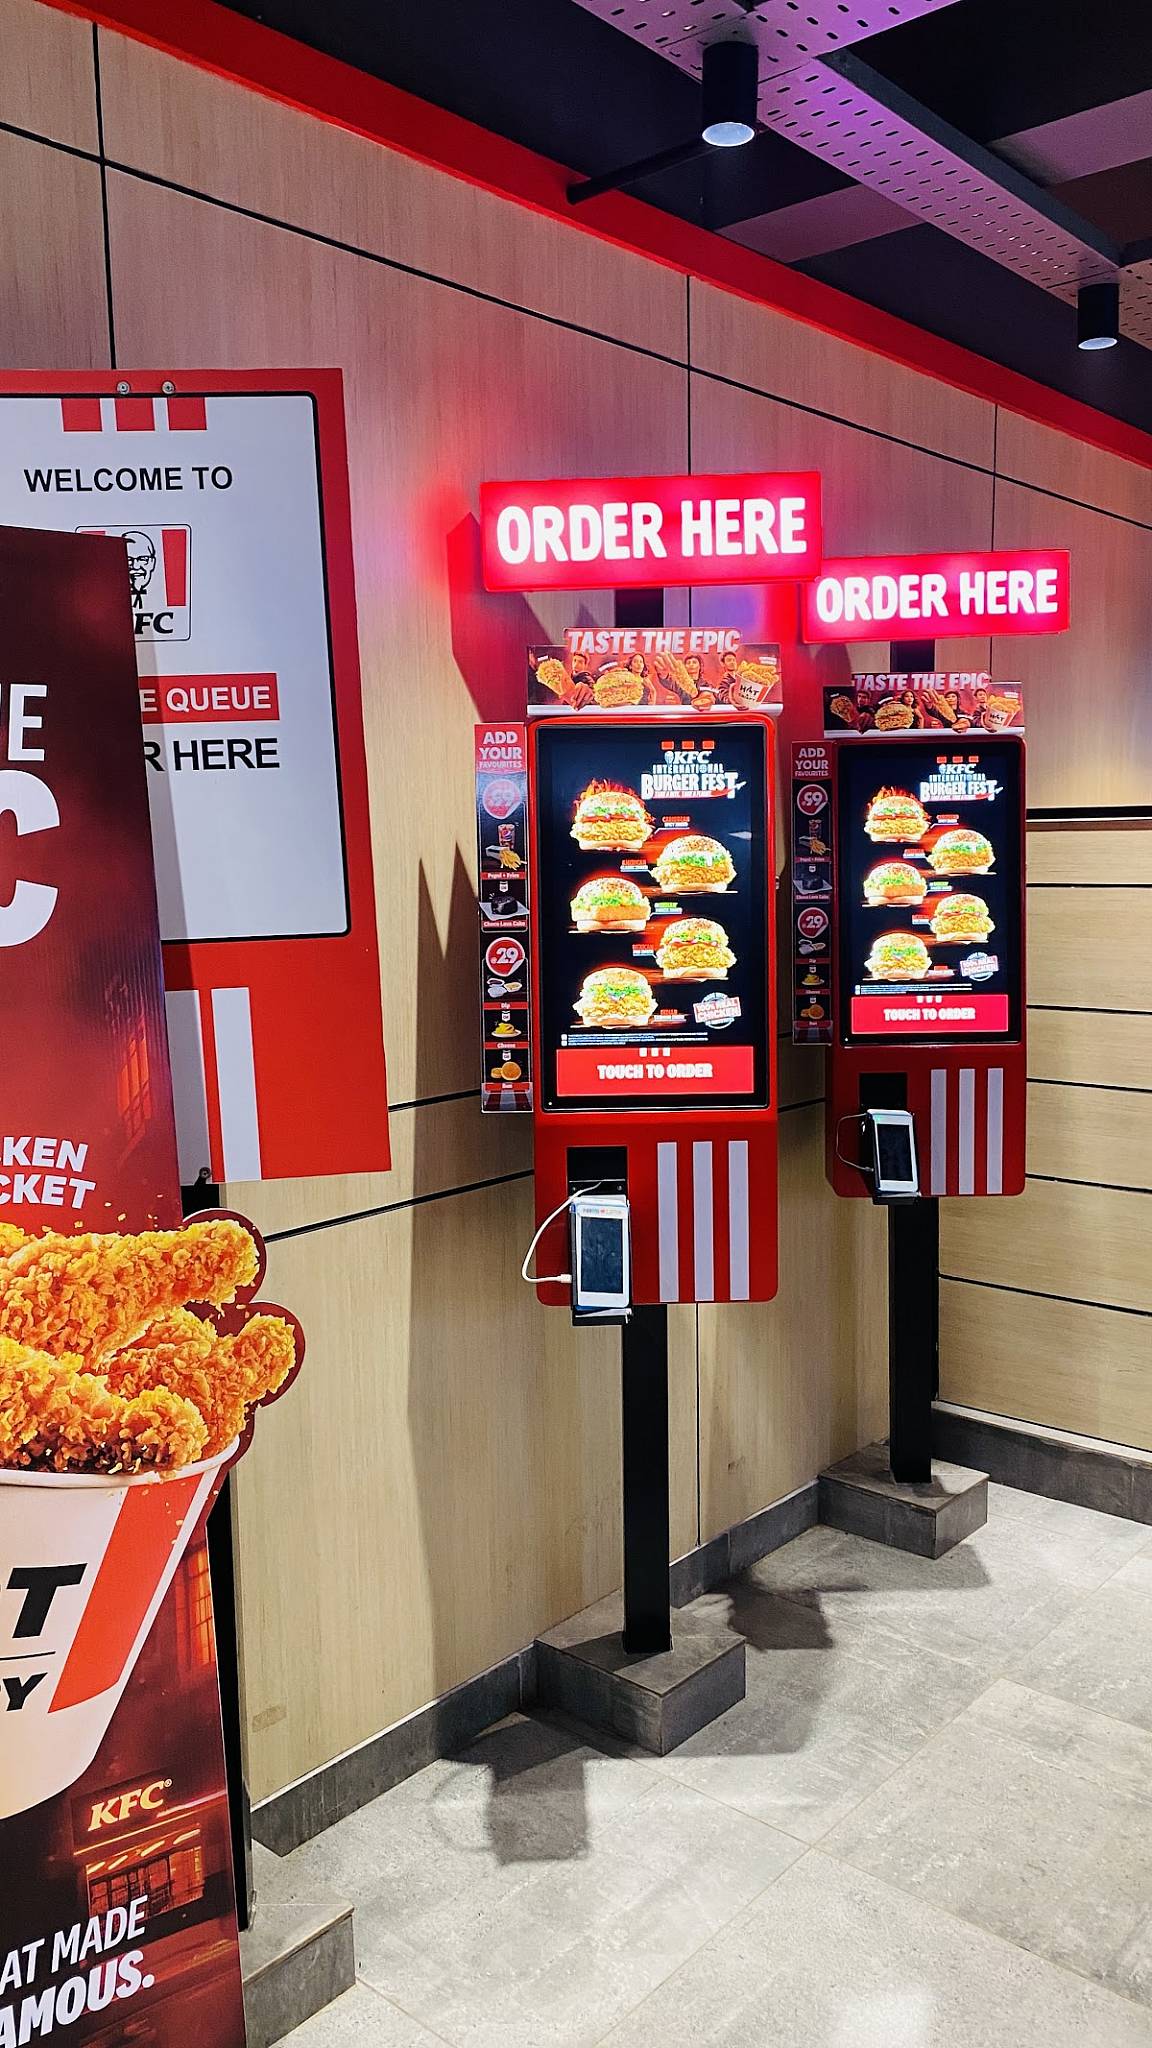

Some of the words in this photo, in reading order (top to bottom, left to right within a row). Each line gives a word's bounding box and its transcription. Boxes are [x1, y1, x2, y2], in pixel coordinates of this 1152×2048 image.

[24, 467, 183, 493] WELCOME
[192, 466, 233, 491] TO
[497, 501, 667, 565] ORDER
[680, 497, 808, 558] HERE
[816, 574, 949, 623] ORDER
[959, 569, 1059, 616] HERE
[568, 630, 636, 655] TASTE
[641, 630, 686, 655] THE
[690, 629, 742, 655] EPIC
[854, 673, 909, 691] TASTE
[911, 673, 946, 691] THE
[949, 672, 991, 691] EPIC
[166, 685, 272, 713] QUEUE
[0, 683, 48, 761] E
[483, 731, 518, 744] ADD
[173, 737, 281, 771] HERE
[479, 746, 522, 760] YOUR
[673, 750, 713, 764] KFC
[798, 747, 826, 758] ADD
[479, 760, 522, 769] FAVOURITES
[652, 763, 724, 774] INTERNATIONAL
[795, 759, 829, 770] YOUR
[945, 763, 977, 774] KFC
[641, 773, 699, 800] BURGER
[701, 772, 739, 799] FEST
[920, 781, 966, 802] BURGER
[967, 780, 998, 801] FEST
[883, 1008, 921, 1021] TOUCH
[922, 1008, 937, 1020] TO
[938, 1007, 976, 1020] ORDER
[597, 1064, 644, 1079] TOUCH
[645, 1064, 665, 1079] TO
[666, 1063, 713, 1078] ORDER
[0, 1136, 88, 1172] KEN
[51, 1895, 149, 1974] MADE
